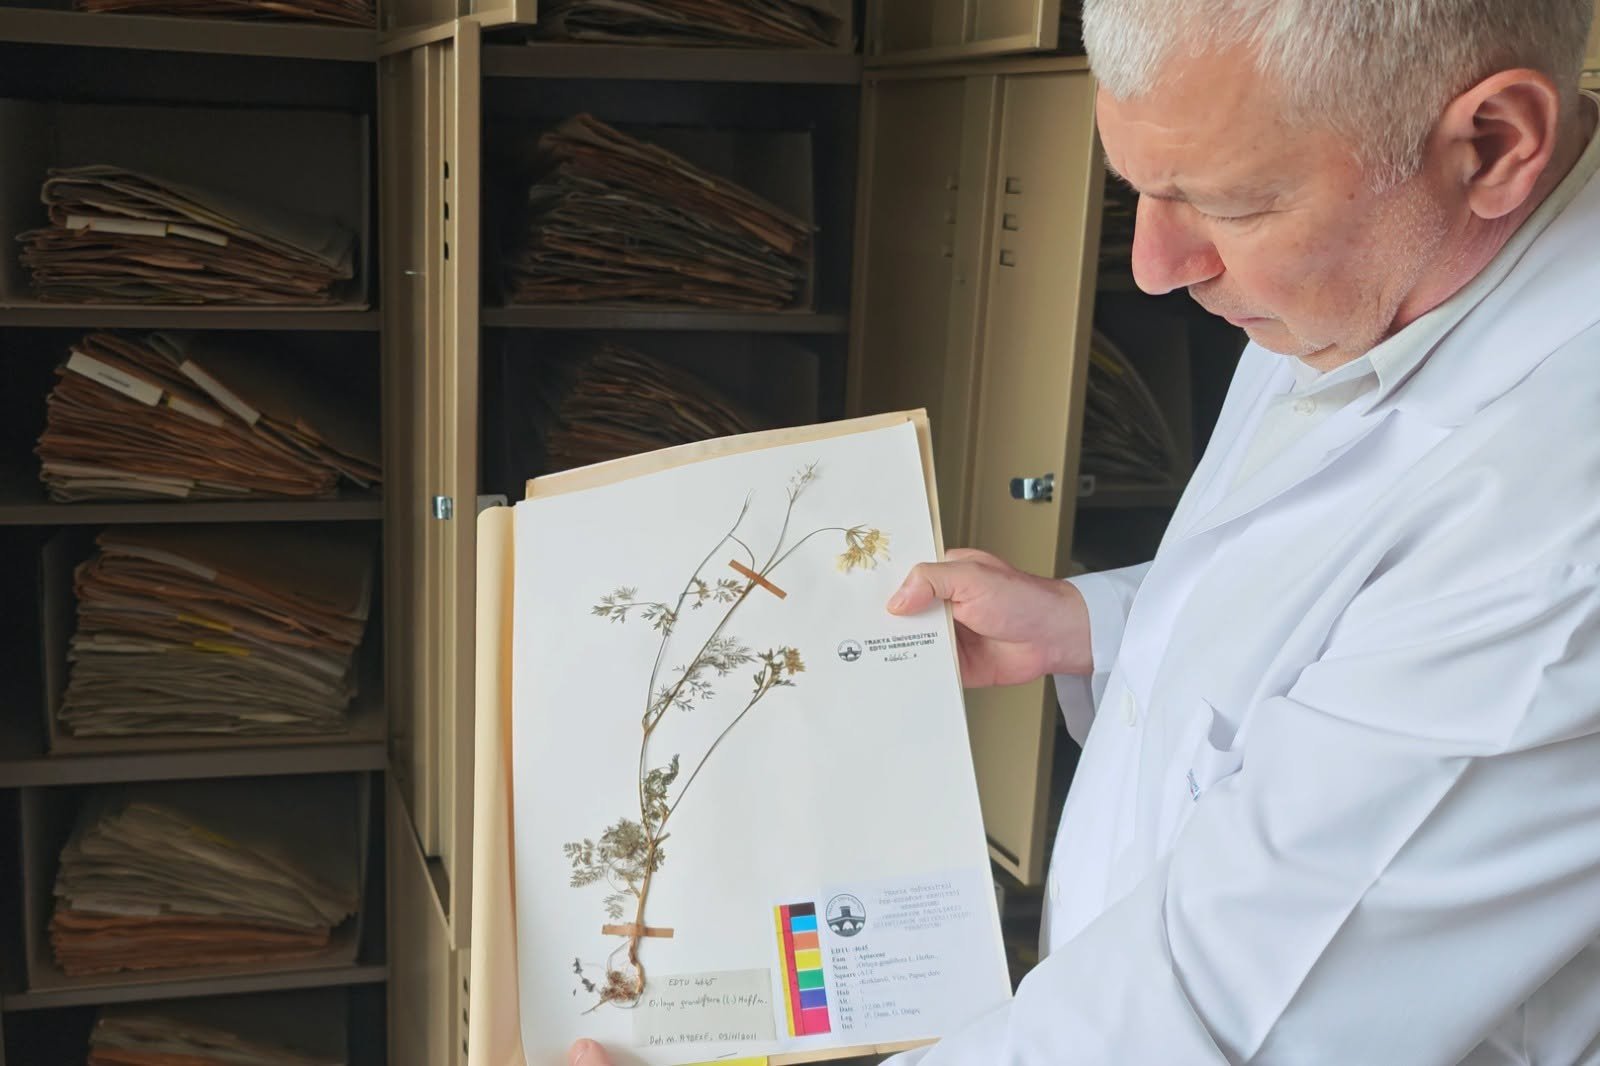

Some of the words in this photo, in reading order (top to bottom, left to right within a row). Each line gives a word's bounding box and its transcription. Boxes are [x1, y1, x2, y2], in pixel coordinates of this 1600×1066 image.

[864, 637, 890, 646] TRAKYA
[869, 644, 887, 652] EDTU
[888, 639, 935, 649] HERBARYUMU
[668, 978, 690, 986] EDTU
